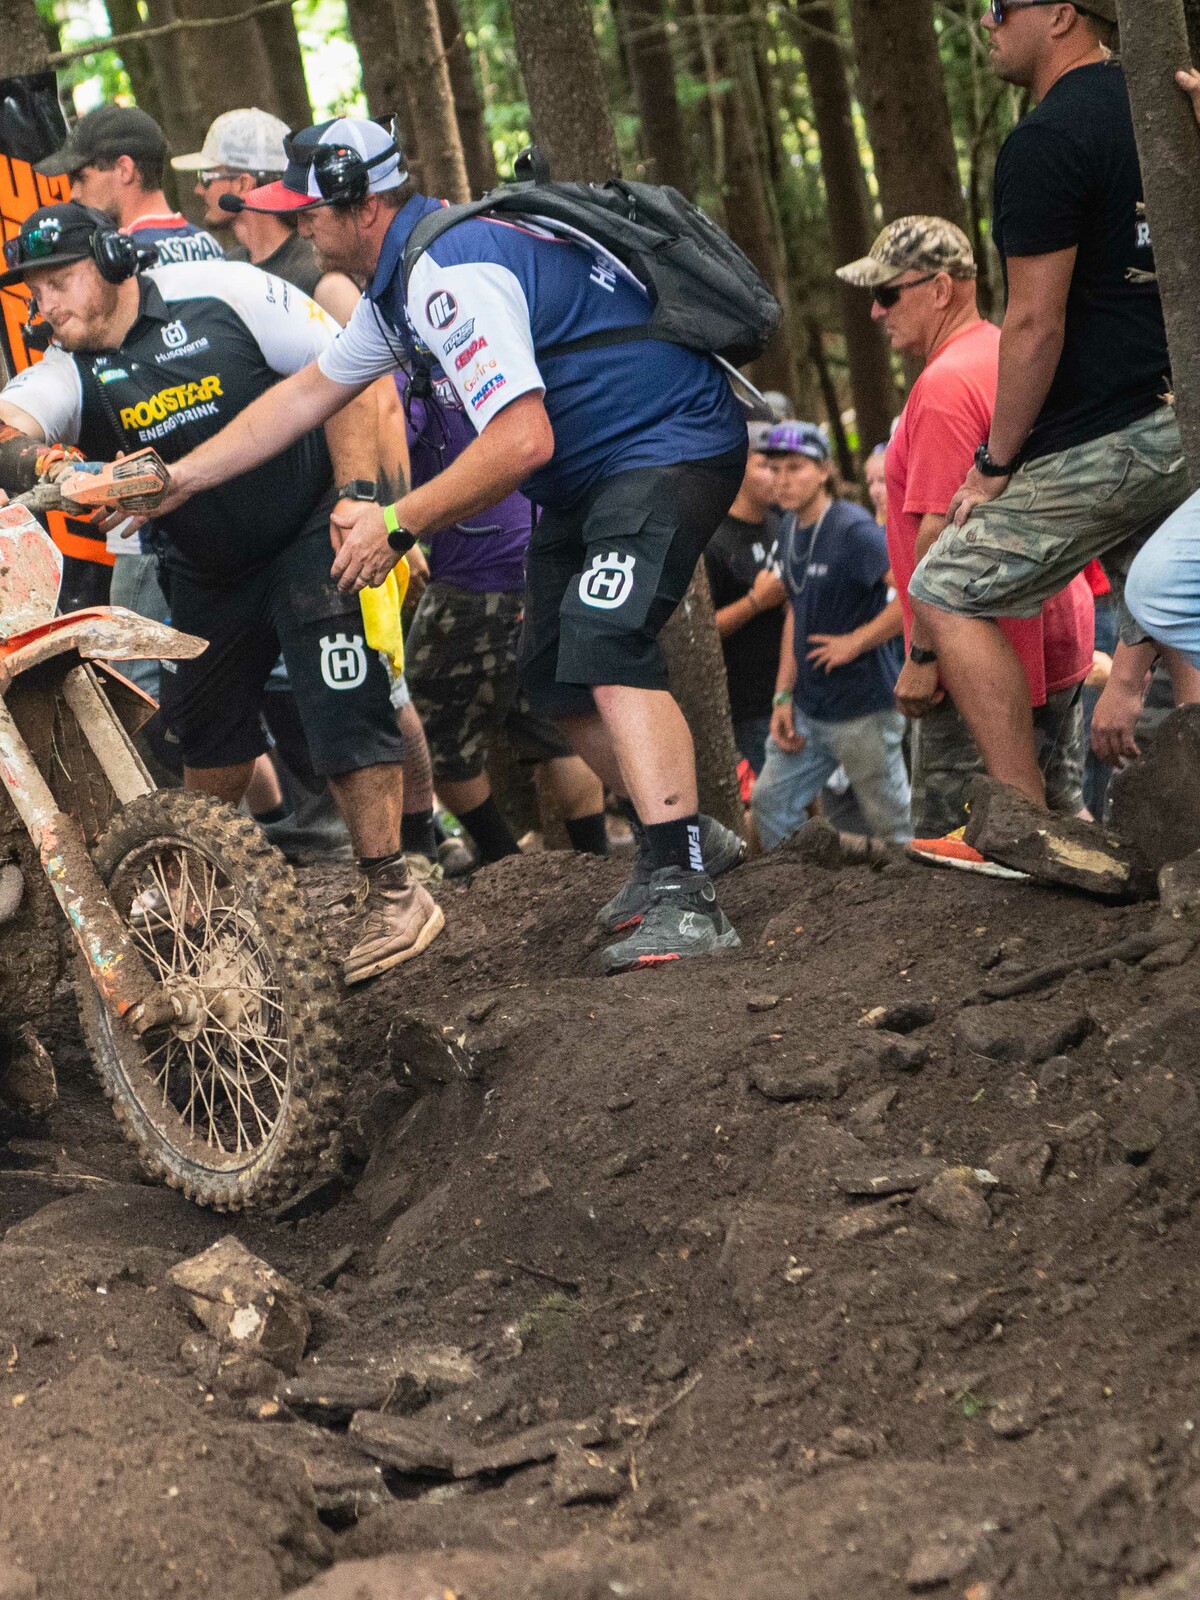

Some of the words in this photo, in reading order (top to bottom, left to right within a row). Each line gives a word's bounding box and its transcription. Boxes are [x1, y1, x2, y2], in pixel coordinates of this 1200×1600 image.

[155, 336, 211, 363] Husqvarna
[120, 375, 224, 430] ROOSTAR
[471, 373, 504, 407] PARTS
[176, 401, 219, 425] DRINK
